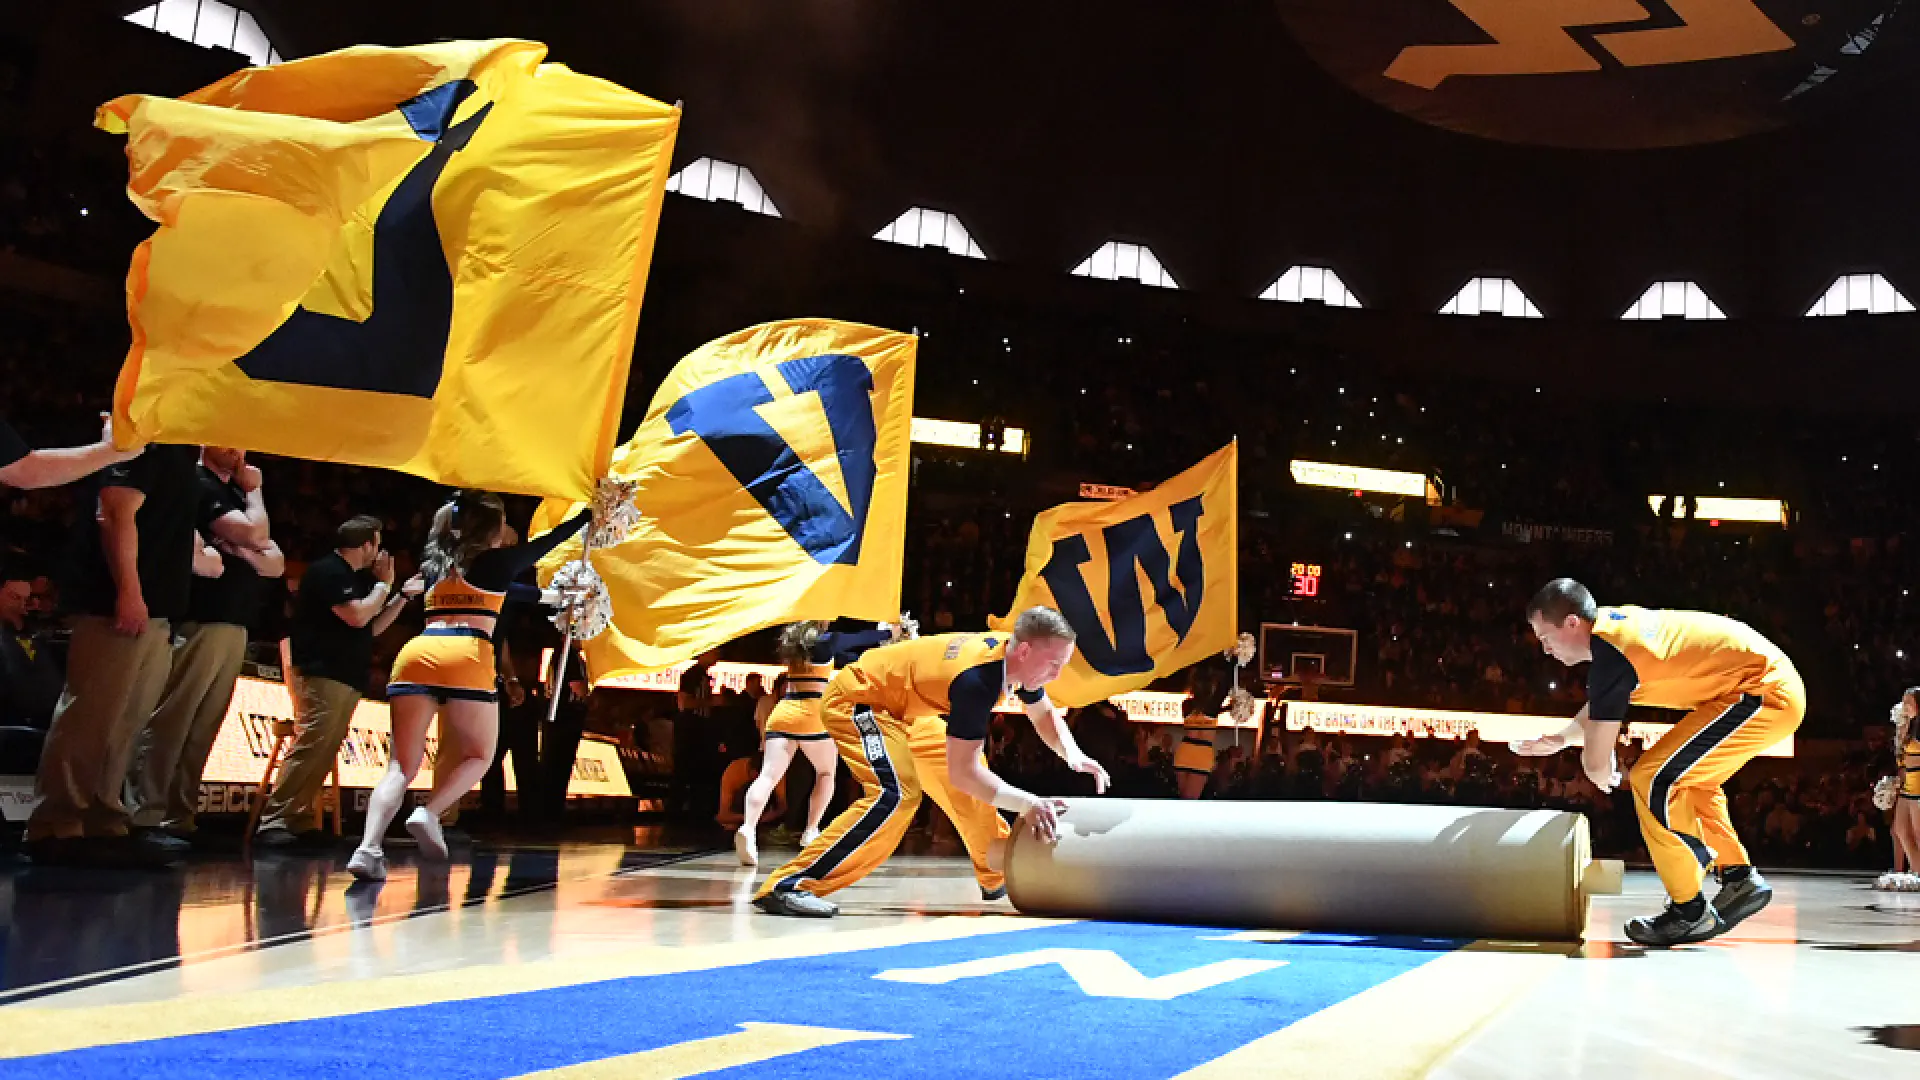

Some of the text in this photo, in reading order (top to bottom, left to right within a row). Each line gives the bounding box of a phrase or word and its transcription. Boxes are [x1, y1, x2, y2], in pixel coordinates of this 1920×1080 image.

[1038, 492, 1205, 677] W
[1294, 575, 1319, 596] 30
[1293, 709, 1320, 726] LET'S
[1325, 712, 1357, 728] BRING
[1360, 713, 1375, 729] ON
[1379, 715, 1397, 731] THE
